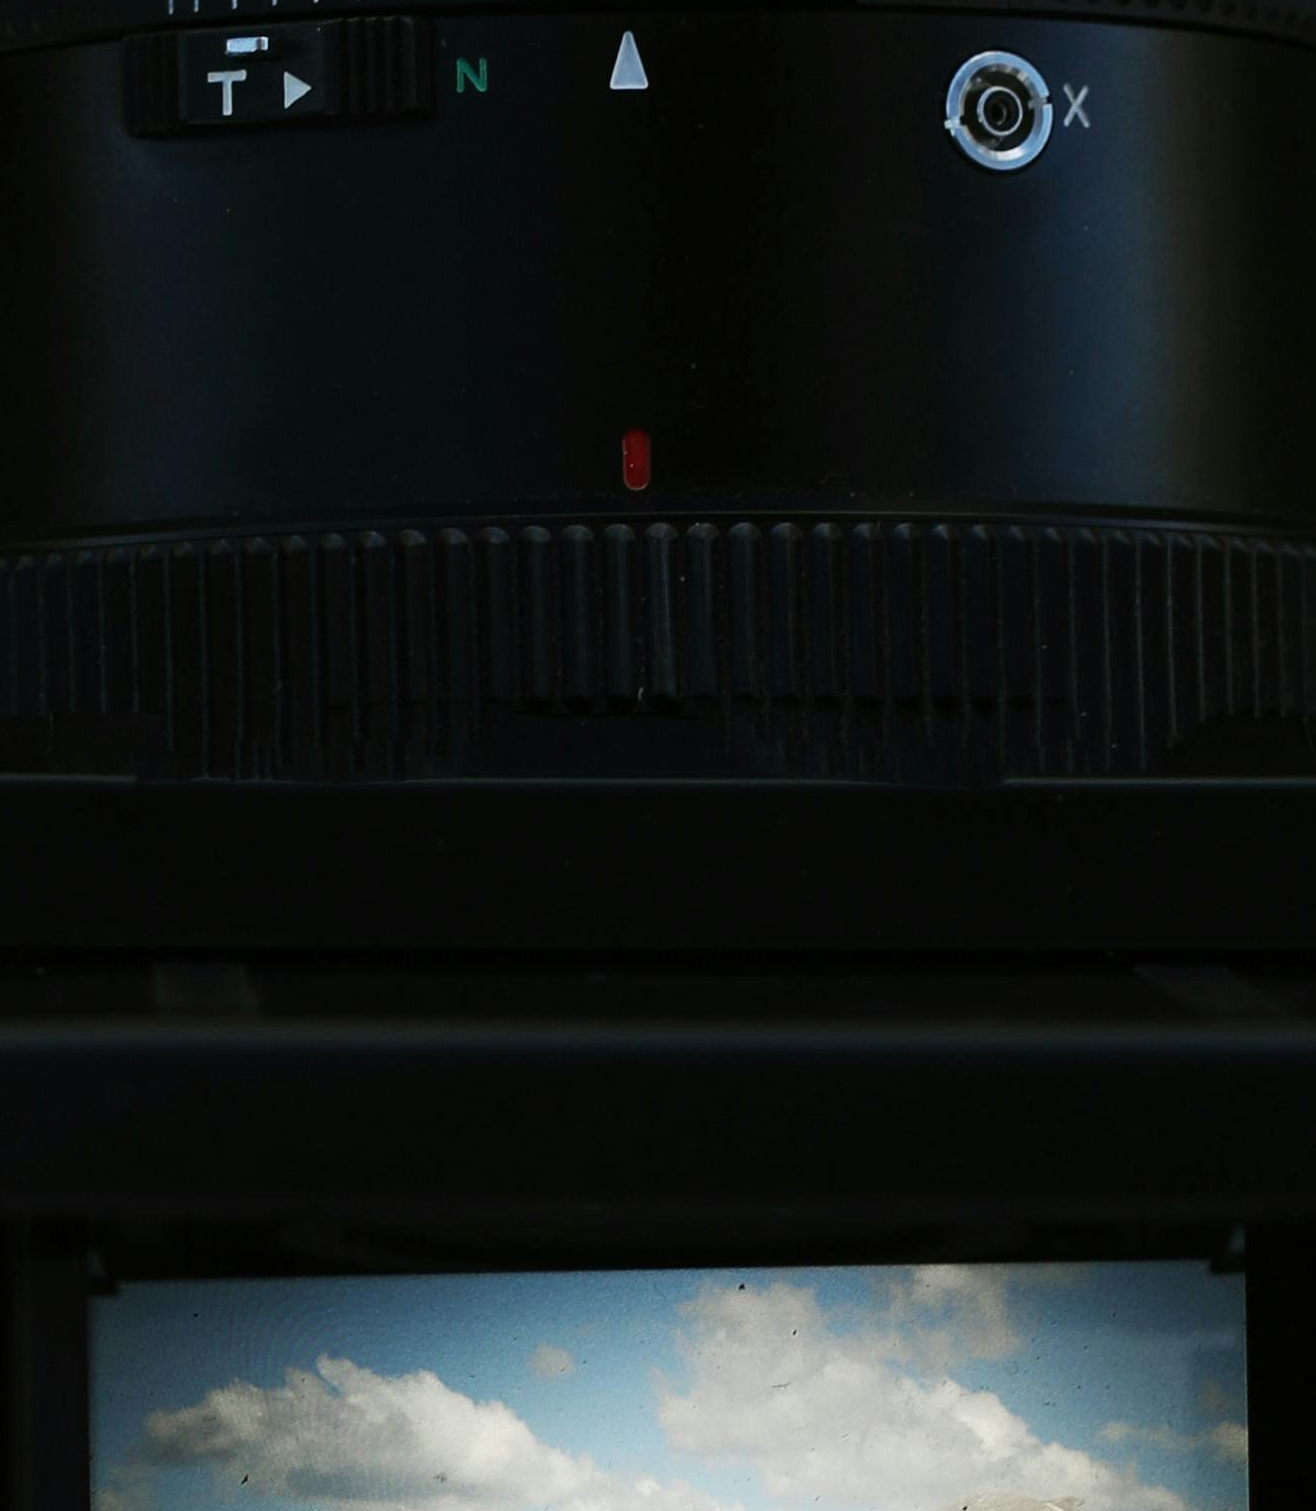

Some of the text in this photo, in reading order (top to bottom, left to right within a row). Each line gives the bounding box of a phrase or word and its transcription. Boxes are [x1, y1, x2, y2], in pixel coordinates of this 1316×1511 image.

[207, 58, 488, 116] T N
[1063, 82, 1090, 128] X
